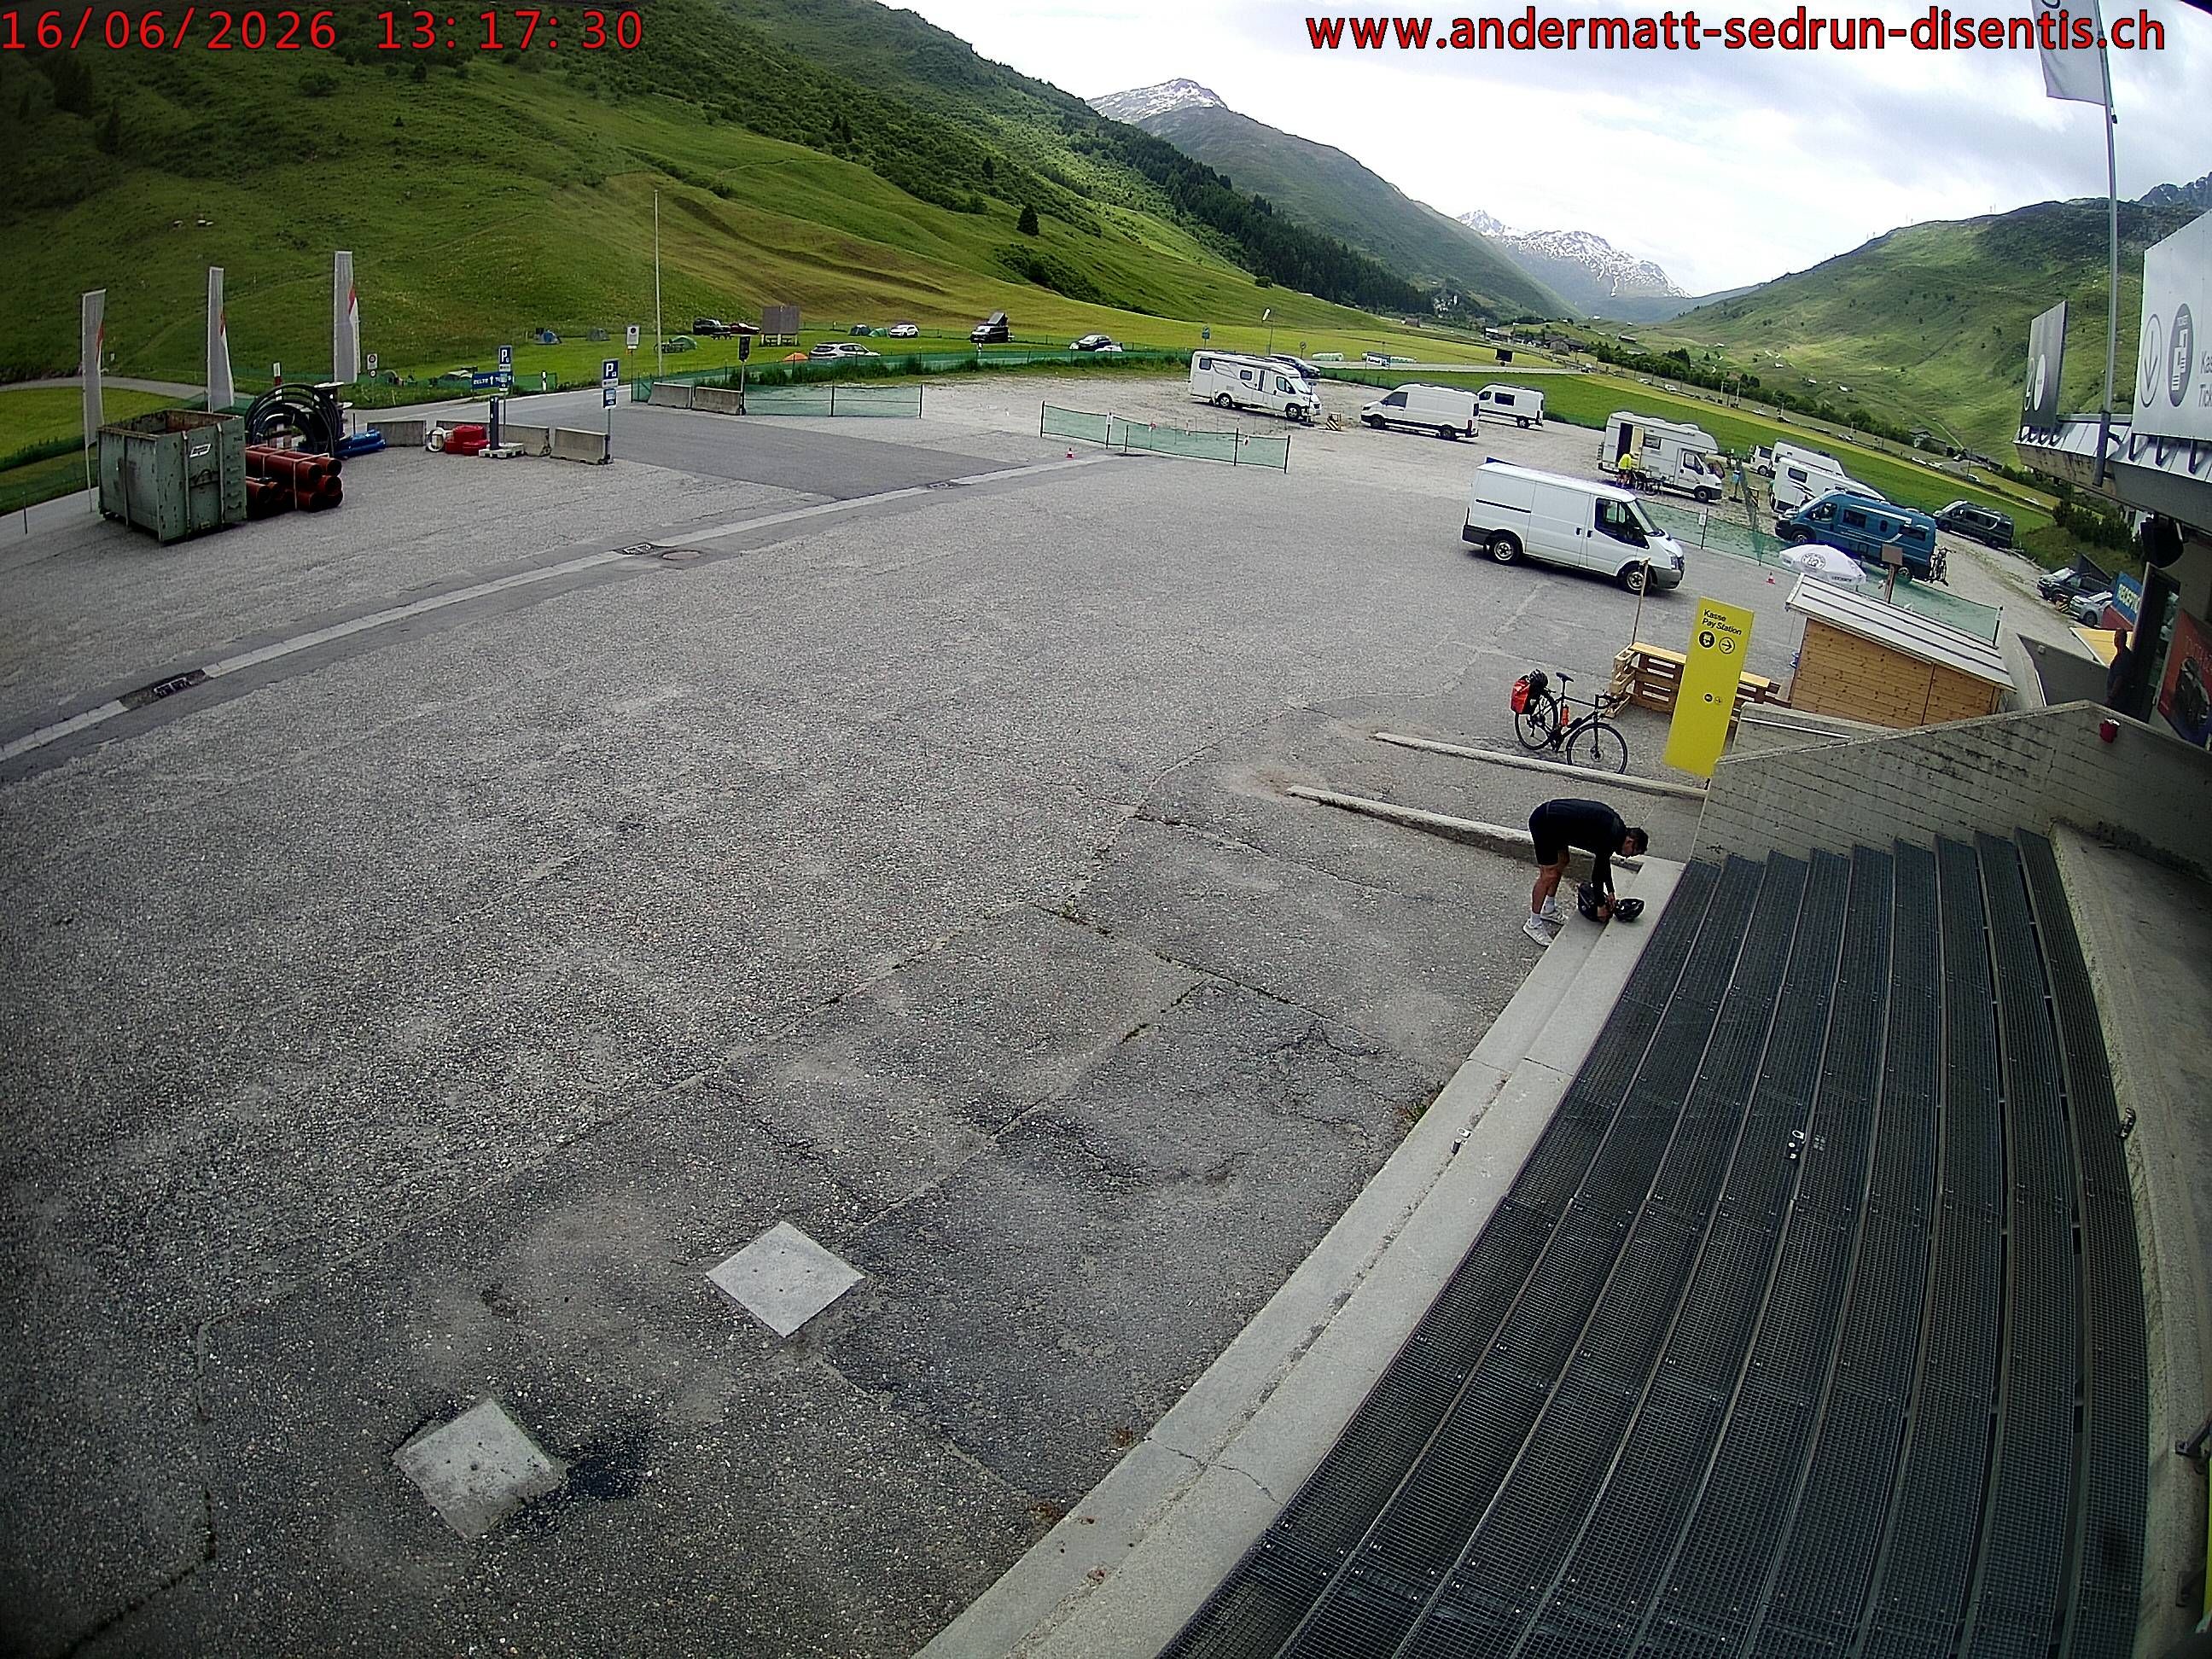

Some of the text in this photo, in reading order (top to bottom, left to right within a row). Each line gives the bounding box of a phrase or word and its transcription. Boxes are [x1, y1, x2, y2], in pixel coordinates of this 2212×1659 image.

[501, 349, 508, 363] P
[605, 363, 614, 377] P
[1703, 608, 1727, 622] Kasse
[1702, 617, 1743, 636] Pay Station
